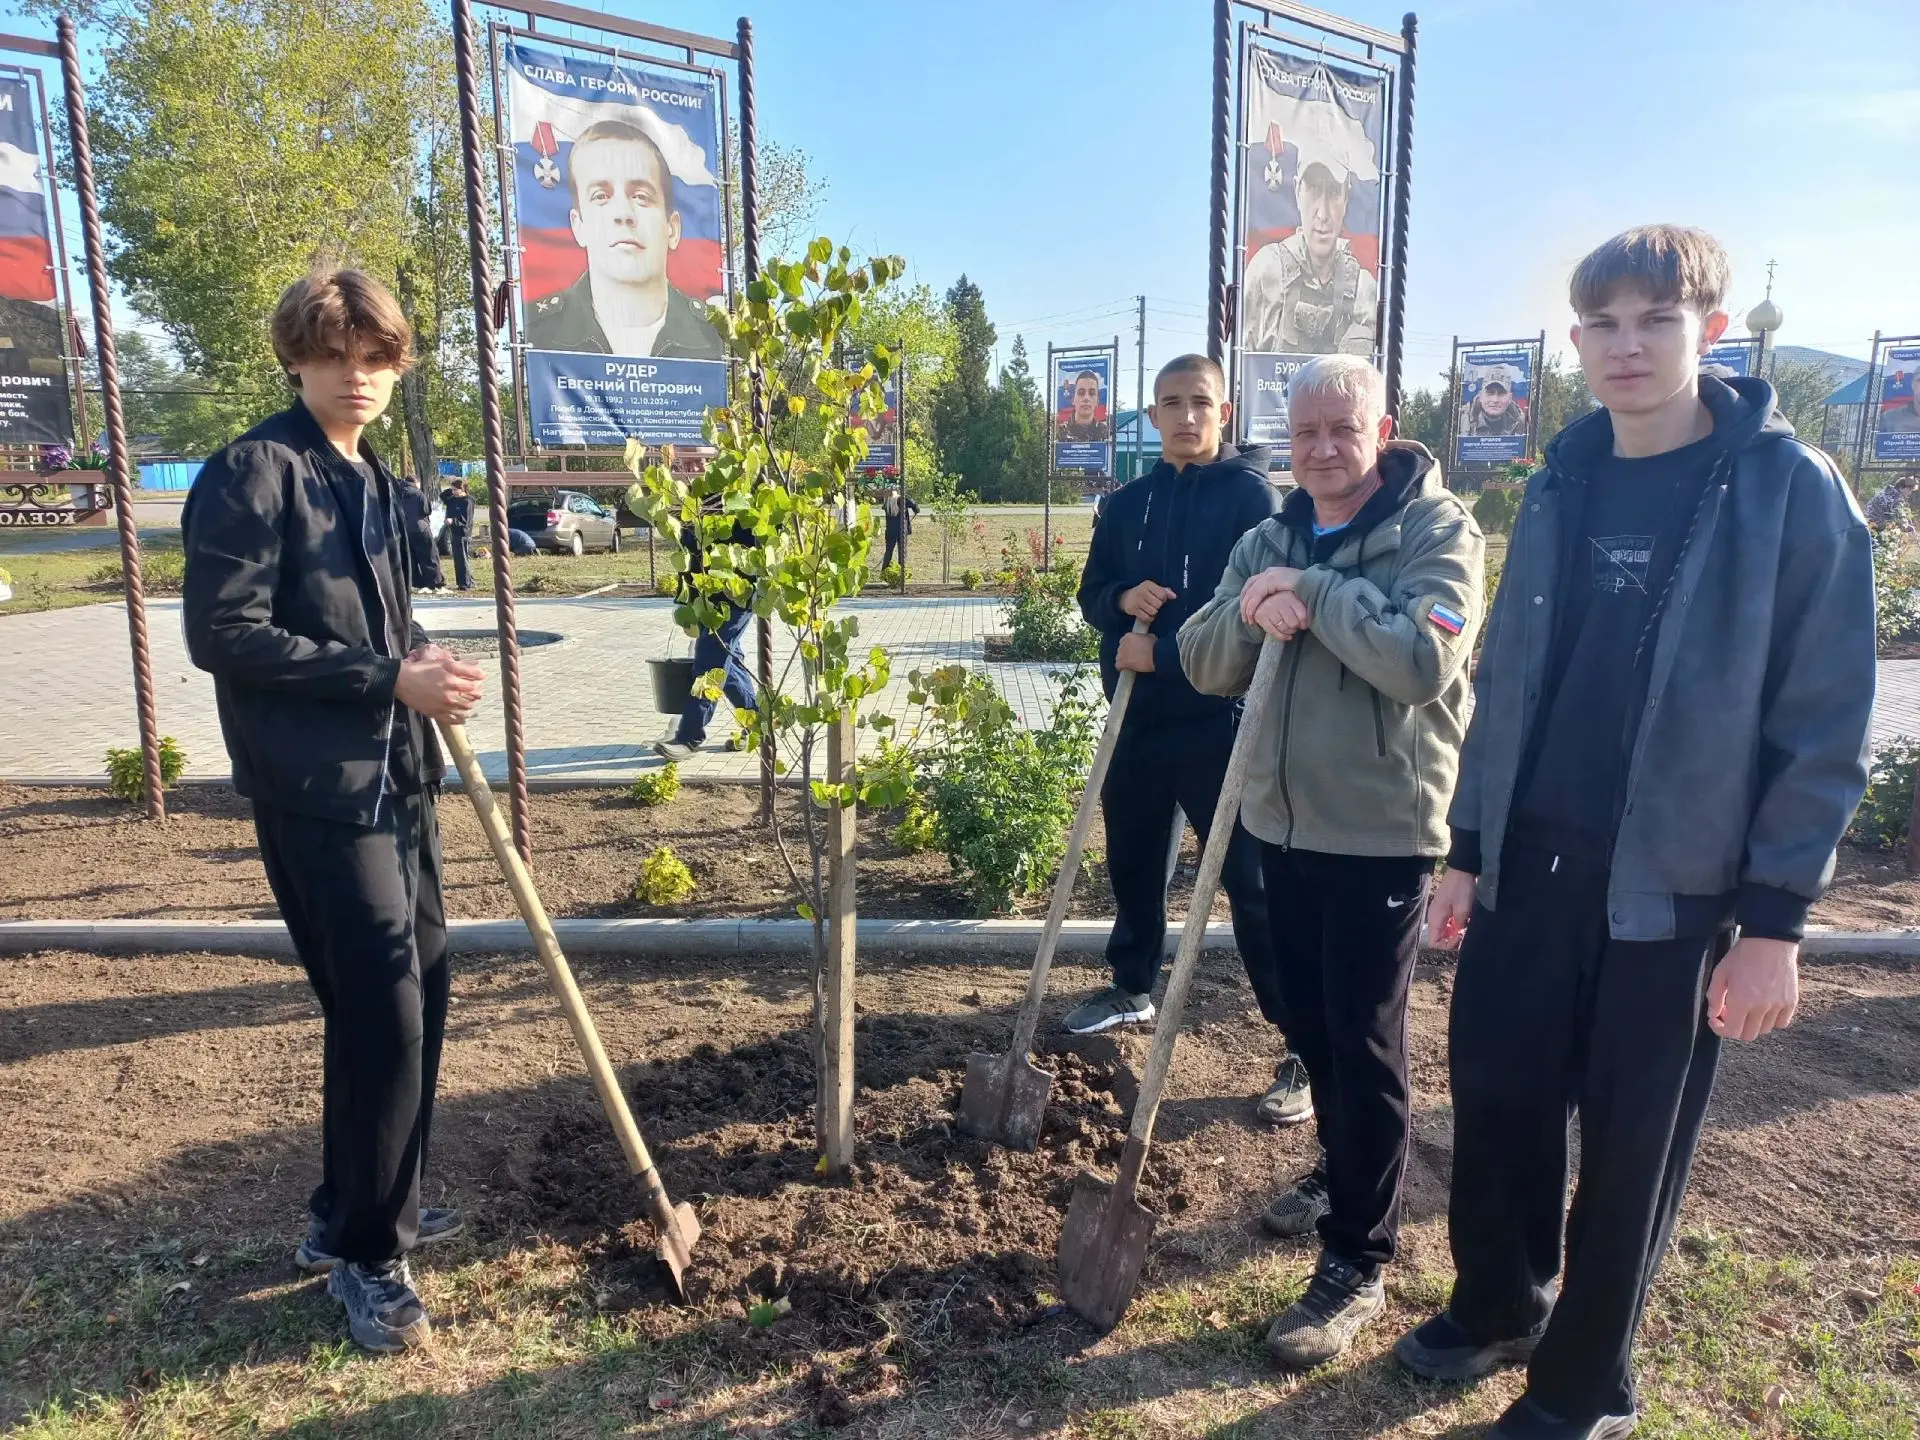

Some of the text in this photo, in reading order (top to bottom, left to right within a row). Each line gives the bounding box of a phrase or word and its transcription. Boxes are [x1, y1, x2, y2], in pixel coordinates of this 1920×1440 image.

[523, 64, 703, 109] СЛАВА ГЕРОЯМ РОССИИ!
[605, 362, 658, 379] РУДЕР
[1275, 361, 1307, 375] БУРА
[0, 376, 51, 387] рович
[557, 376, 702, 396] Евгений Петрович
[1257, 379, 1289, 393] Влади
[605, 396, 623, 404] 1992
[630, 397, 669, 406] 12.10.2024
[583, 405, 624, 416] Донецкой
[626, 408, 663, 416] народной
[665, 409, 703, 418] республи
